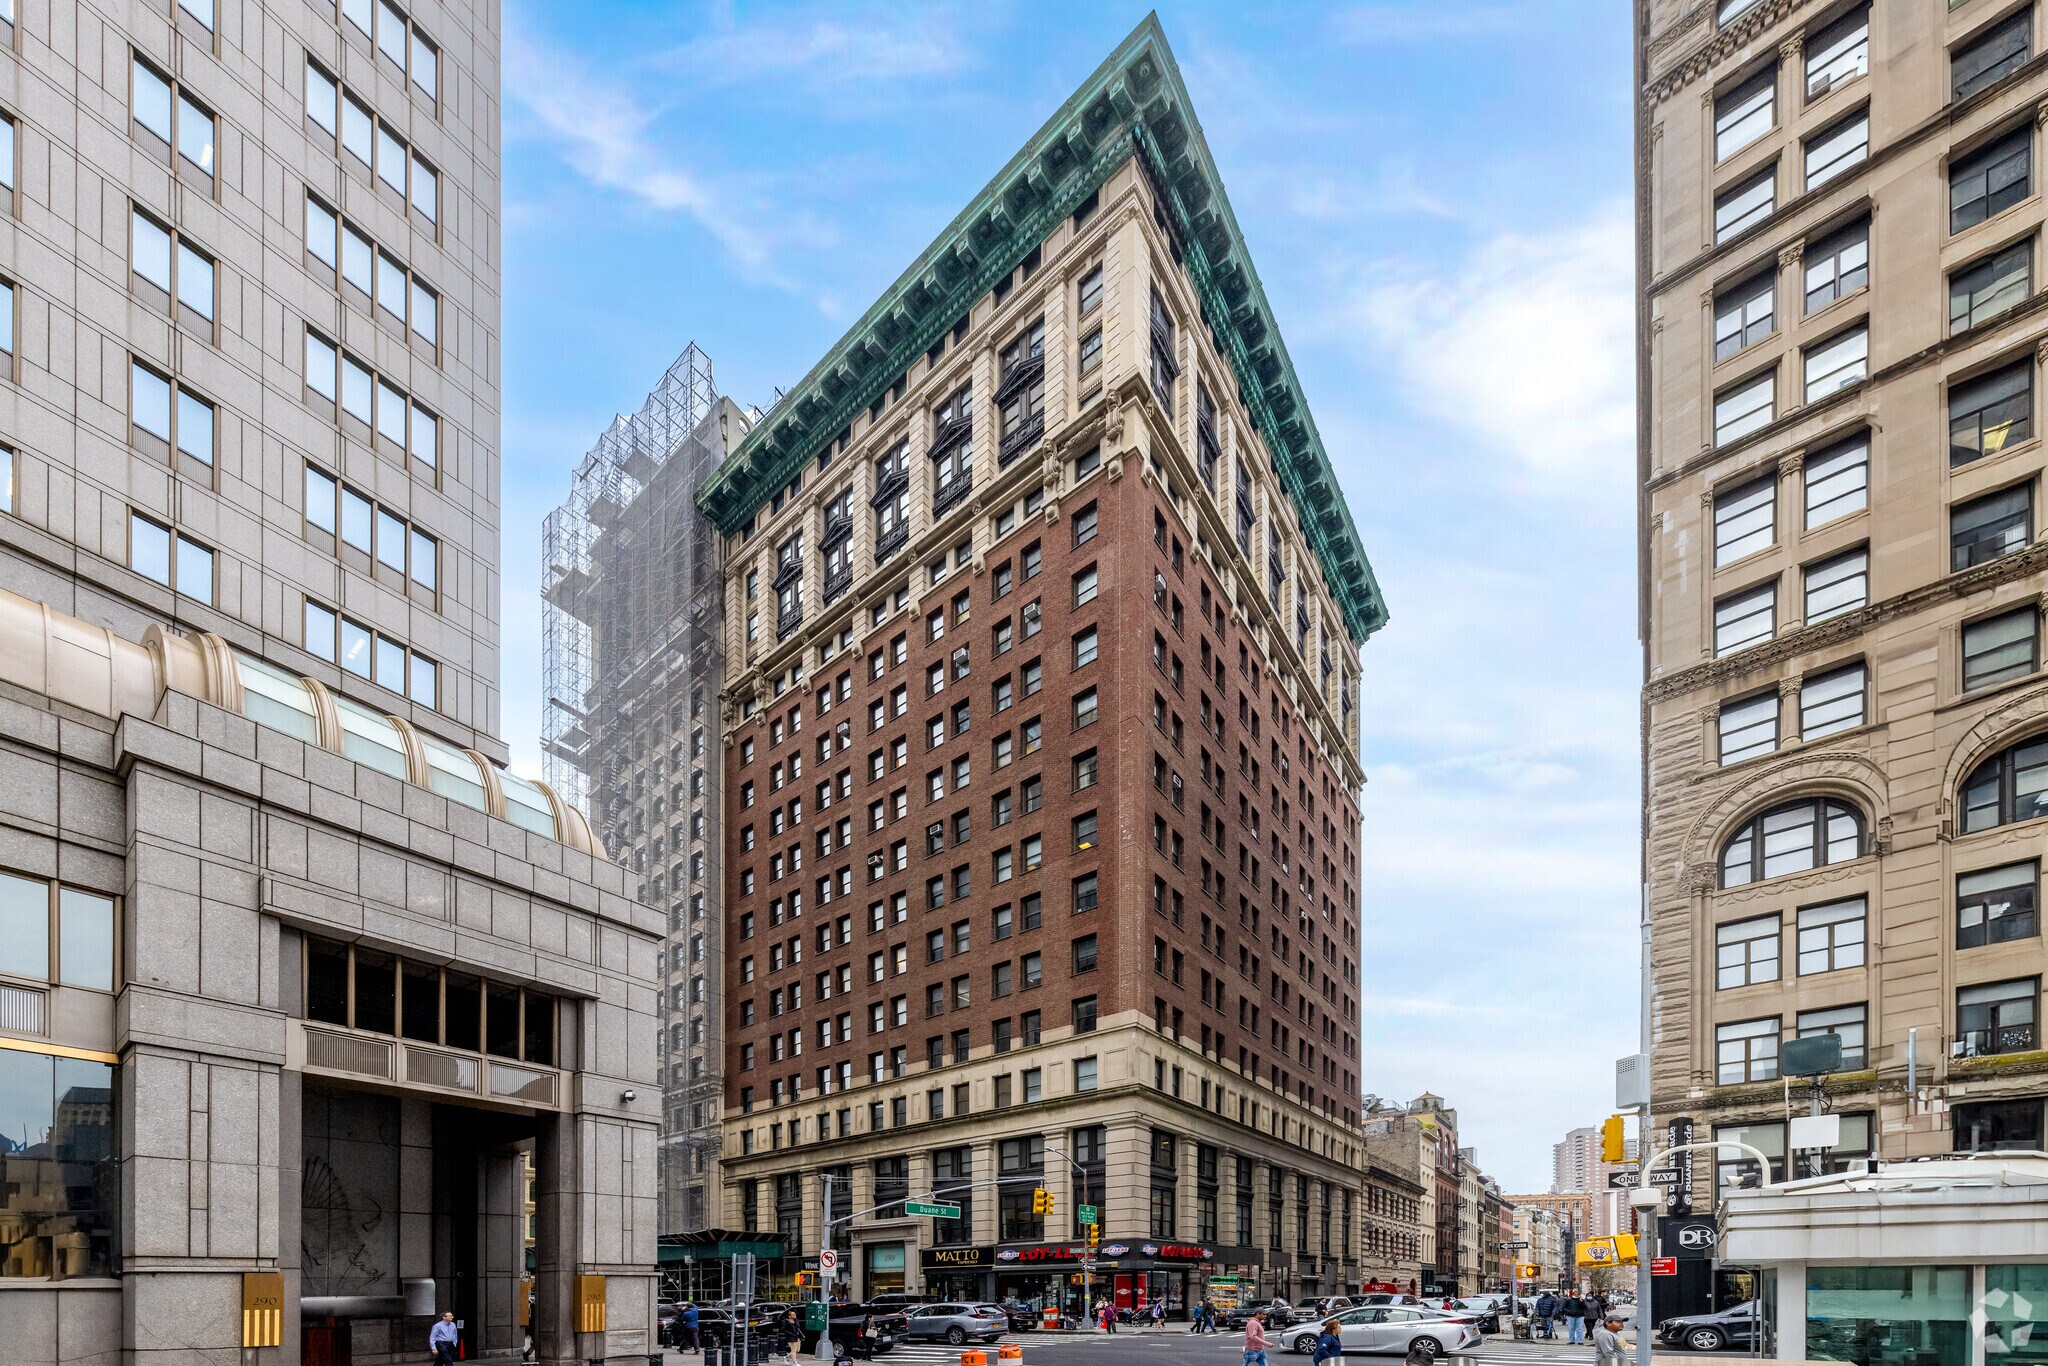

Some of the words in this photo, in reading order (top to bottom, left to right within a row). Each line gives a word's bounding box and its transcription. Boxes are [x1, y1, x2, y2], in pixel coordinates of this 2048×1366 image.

[1668, 1126, 1676, 1193] DErade
[1619, 1175, 1639, 1184] ONE
[1650, 1173, 1672, 1181] WAY
[919, 1205, 939, 1215] Duane
[940, 1207, 947, 1215] St
[1679, 1229, 1713, 1245] DR
[935, 1250, 979, 1262] MATTO
[253, 1297, 277, 1306] 290
[586, 1293, 601, 1301] 290
